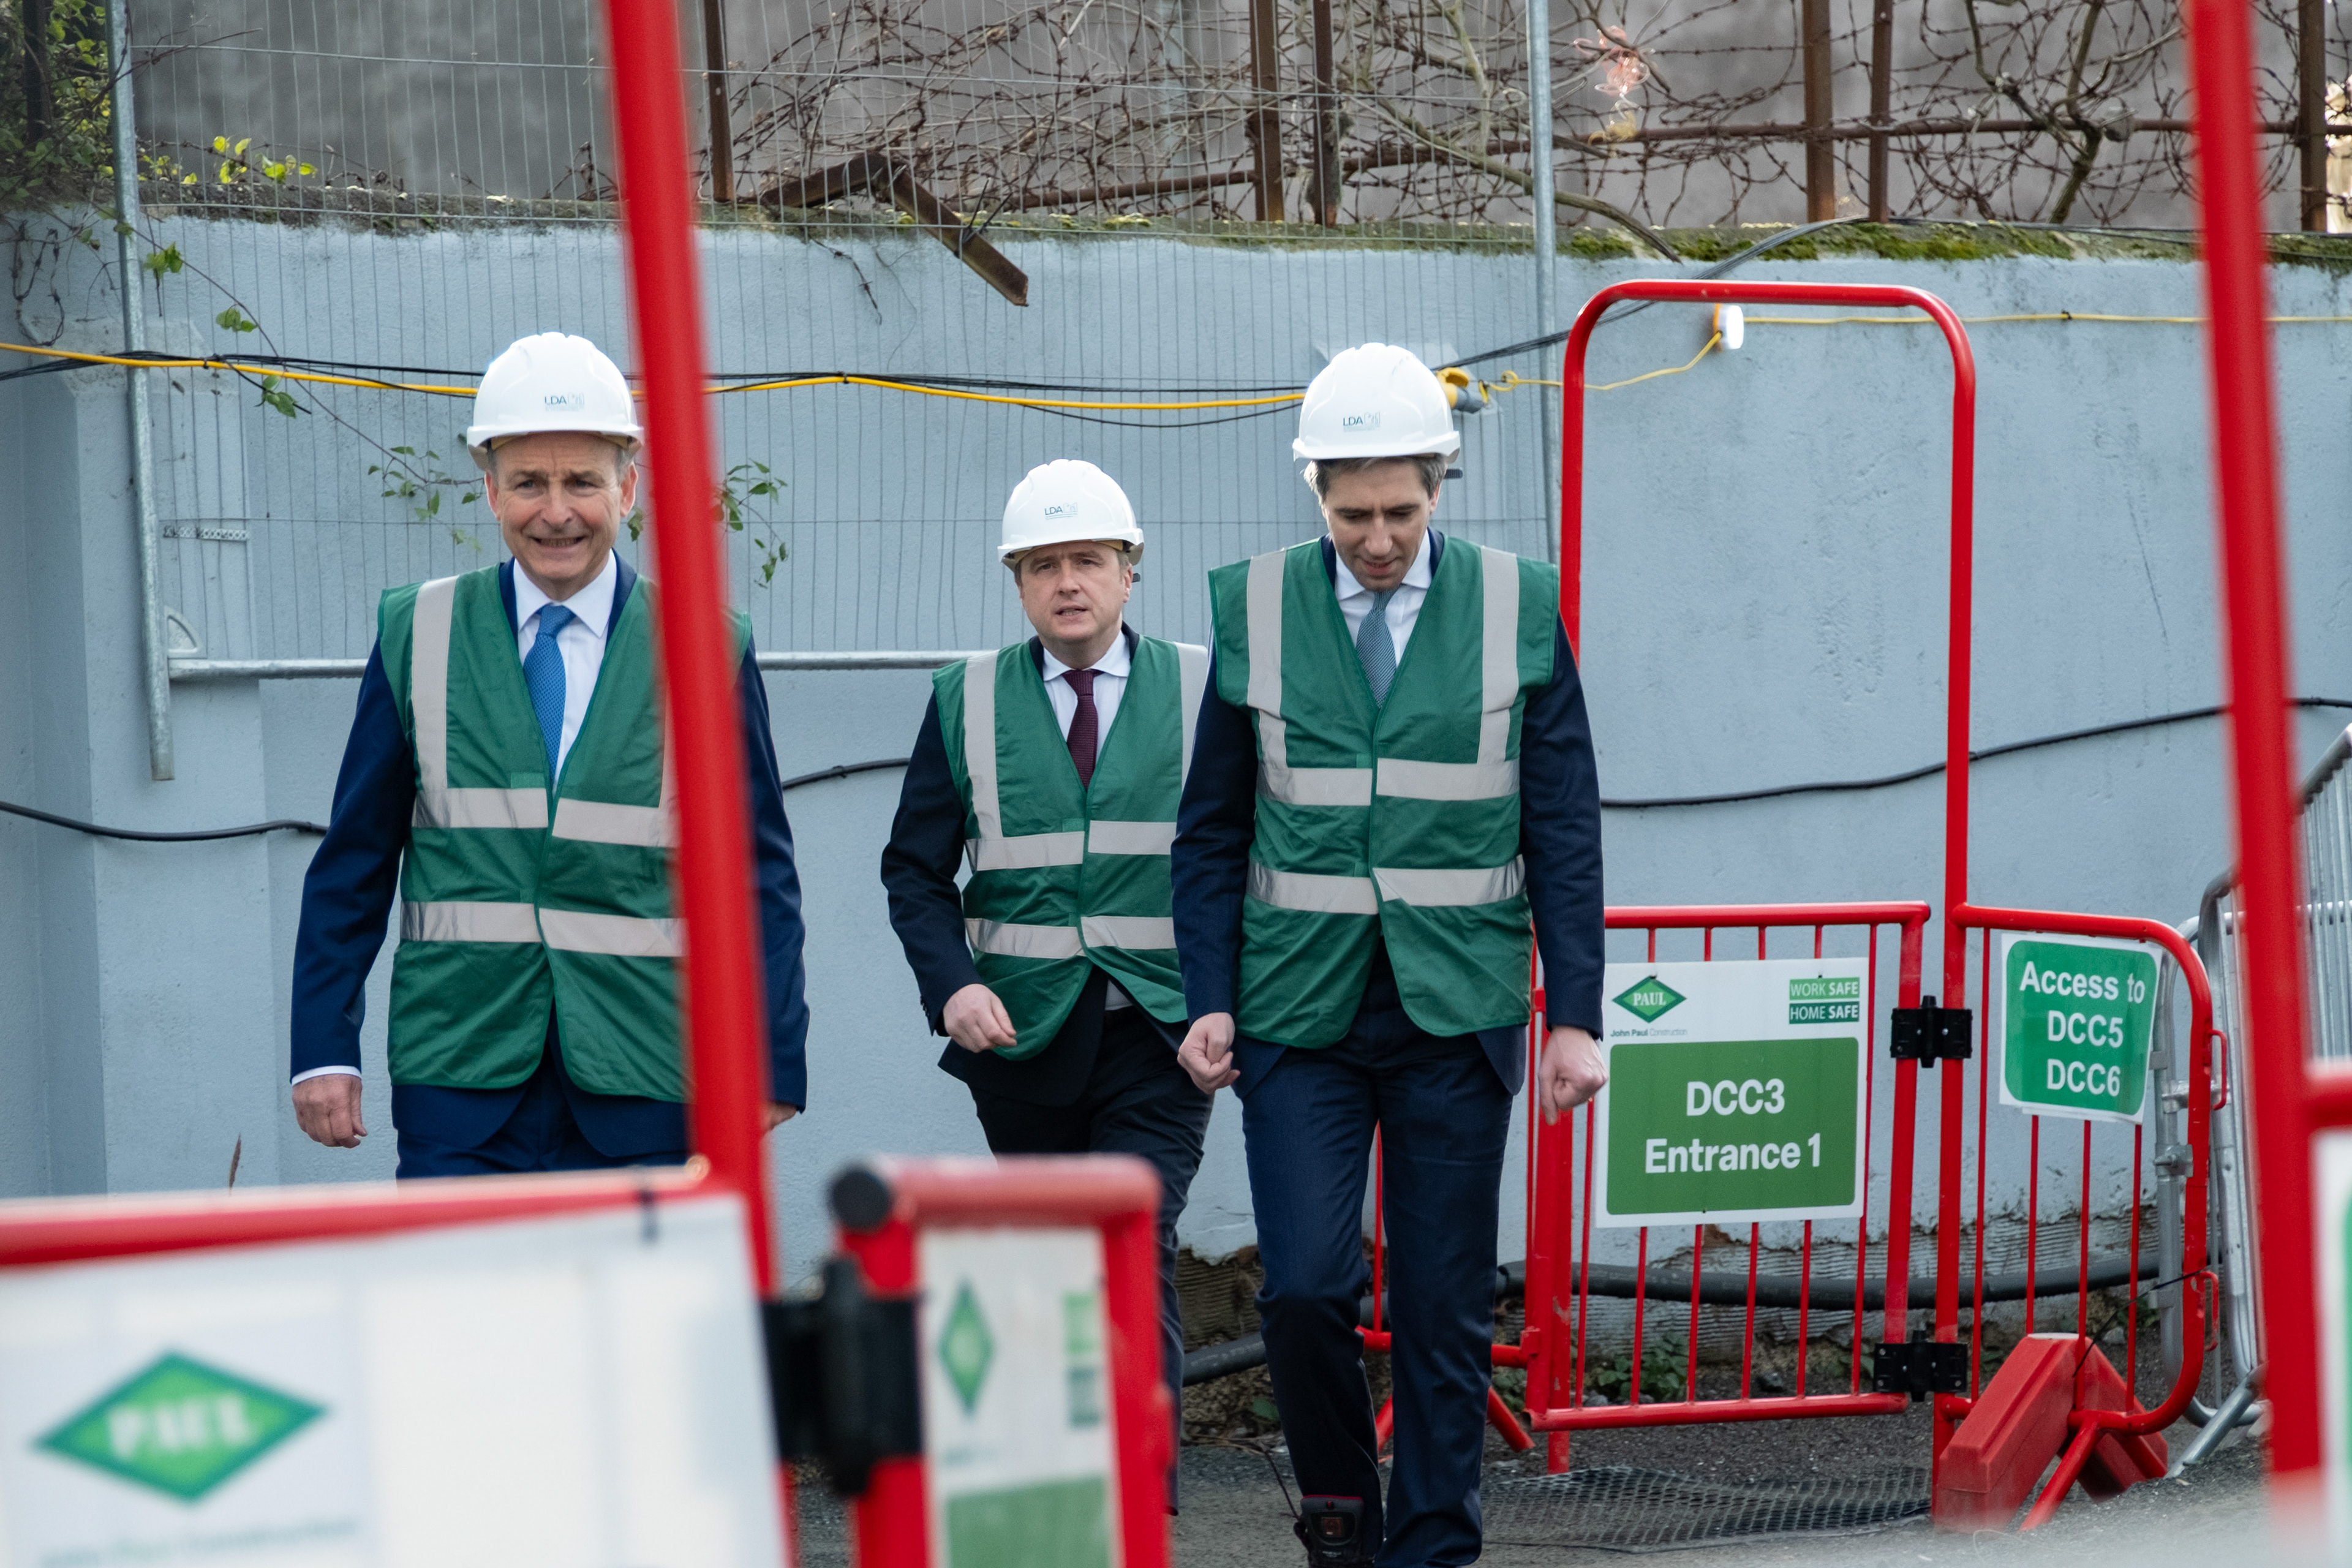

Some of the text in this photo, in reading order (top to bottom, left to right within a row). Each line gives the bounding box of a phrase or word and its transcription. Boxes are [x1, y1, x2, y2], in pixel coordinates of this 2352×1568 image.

[544, 395, 567, 405] LDA
[1343, 416, 1363, 426] LDA
[1044, 506, 1063, 515] LDA
[1790, 981, 1858, 997] WORK SAFE
[2019, 960, 2145, 1004] Access to
[1633, 992, 1667, 1006] PAUL
[1790, 1005, 1858, 1020] HOME SAFE
[2048, 1010, 2124, 1048] DCC5
[2046, 1058, 2121, 1097] DCC6
[1686, 1078, 1785, 1117] DCC3
[1645, 1133, 1821, 1174] Entrance 1
